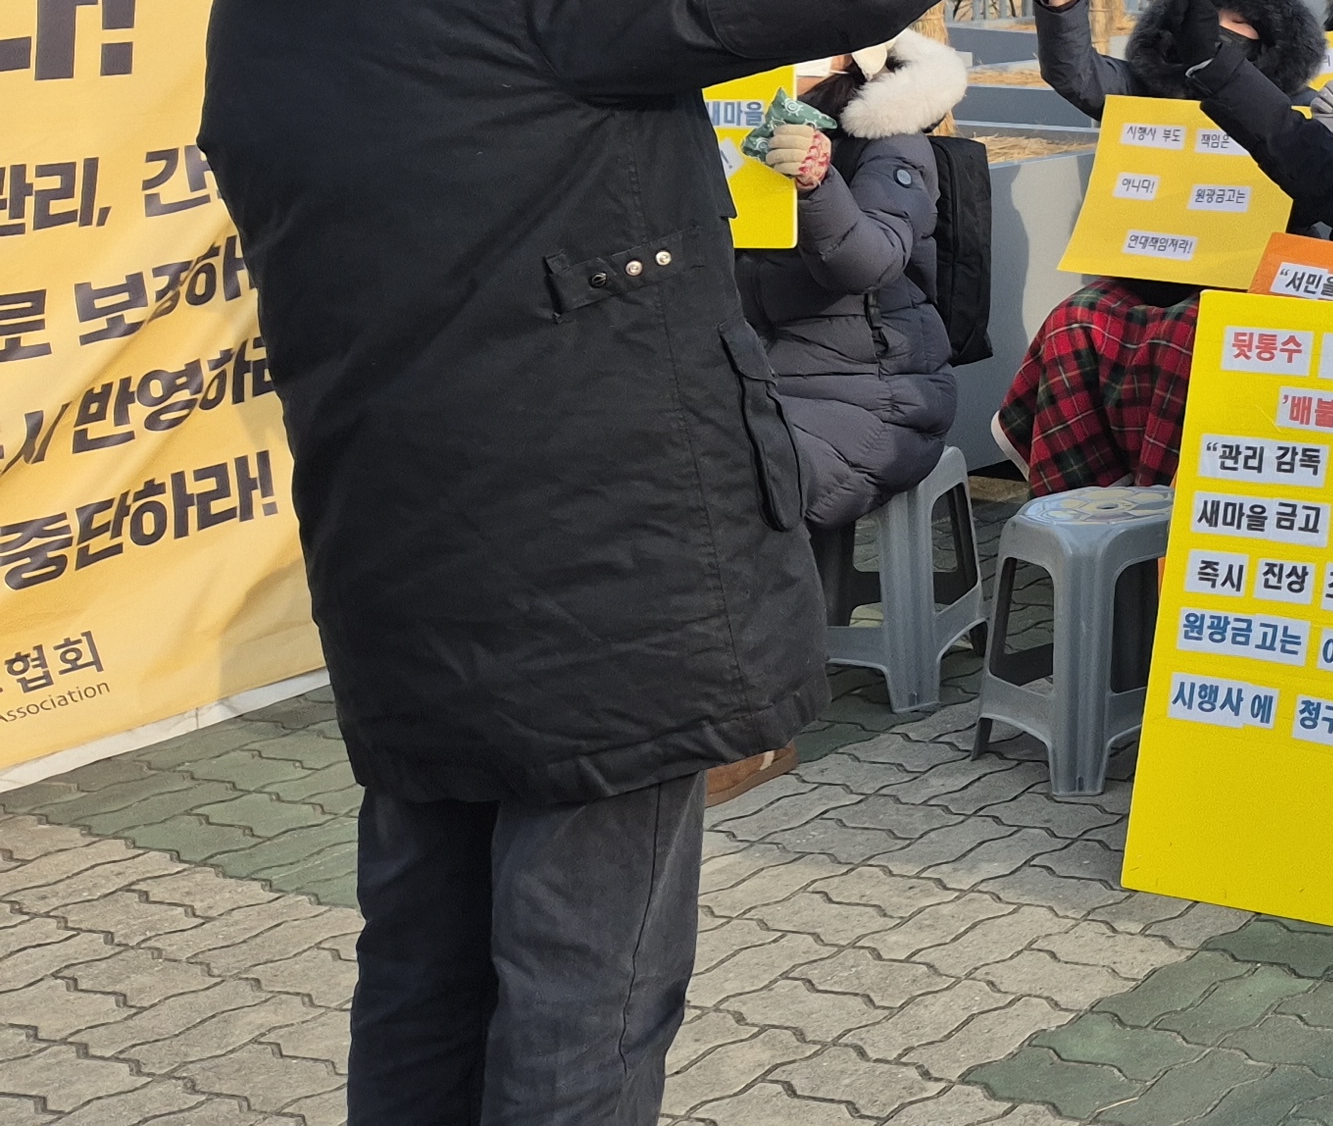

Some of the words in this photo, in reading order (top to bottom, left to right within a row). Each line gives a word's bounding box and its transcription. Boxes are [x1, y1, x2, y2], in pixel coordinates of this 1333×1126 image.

[1127, 125, 1157, 141] 시행사
[1162, 128, 1181, 143] 부도
[1201, 133, 1230, 149] 책임은
[1194, 188, 1246, 204] 원광금고는
[1231, 331, 1303, 364] 뒷통수
[1274, 443, 1322, 476] 감독
[0, 449, 279, 592] 중단하라!
[1196, 559, 1244, 593] 즉시
[1262, 559, 1309, 594] 진상
[1182, 612, 1303, 656] 원광금고는
